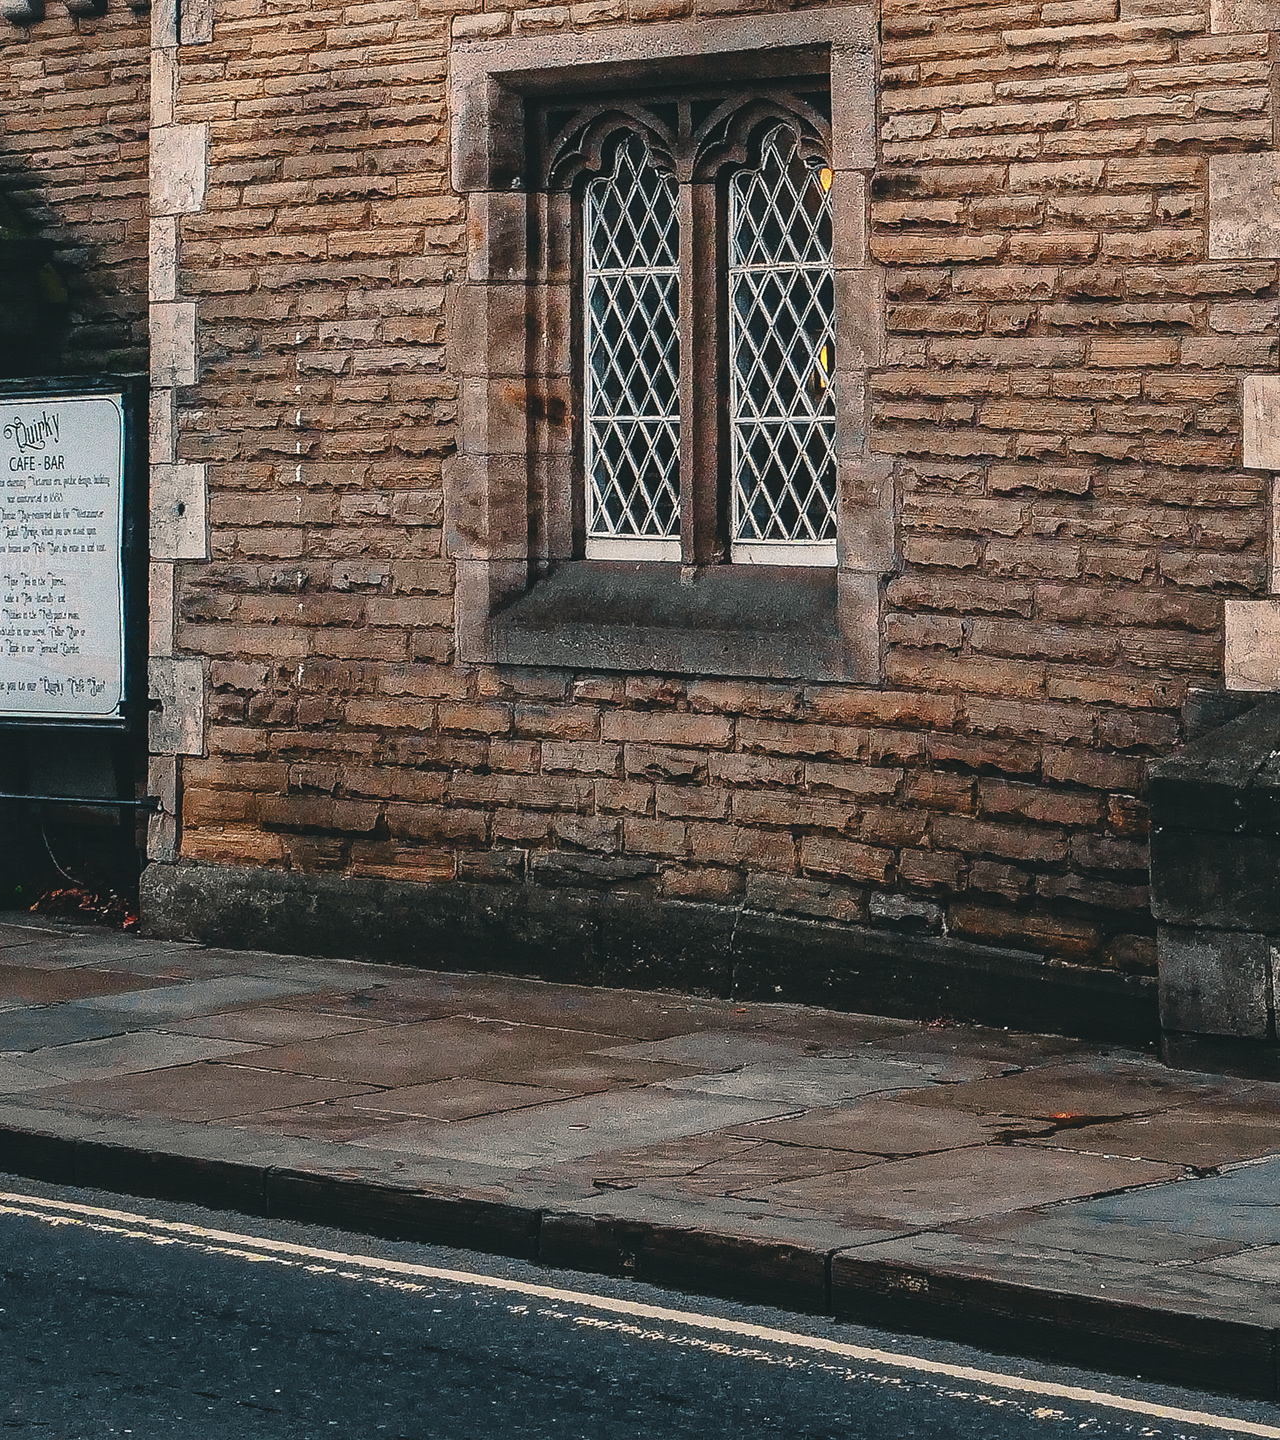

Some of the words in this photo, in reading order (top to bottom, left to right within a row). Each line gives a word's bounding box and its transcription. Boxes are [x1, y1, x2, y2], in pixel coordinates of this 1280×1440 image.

[3, 410, 60, 453] Quirky
[9, 456, 35, 472] CAFE
[44, 455, 65, 470] BAR
